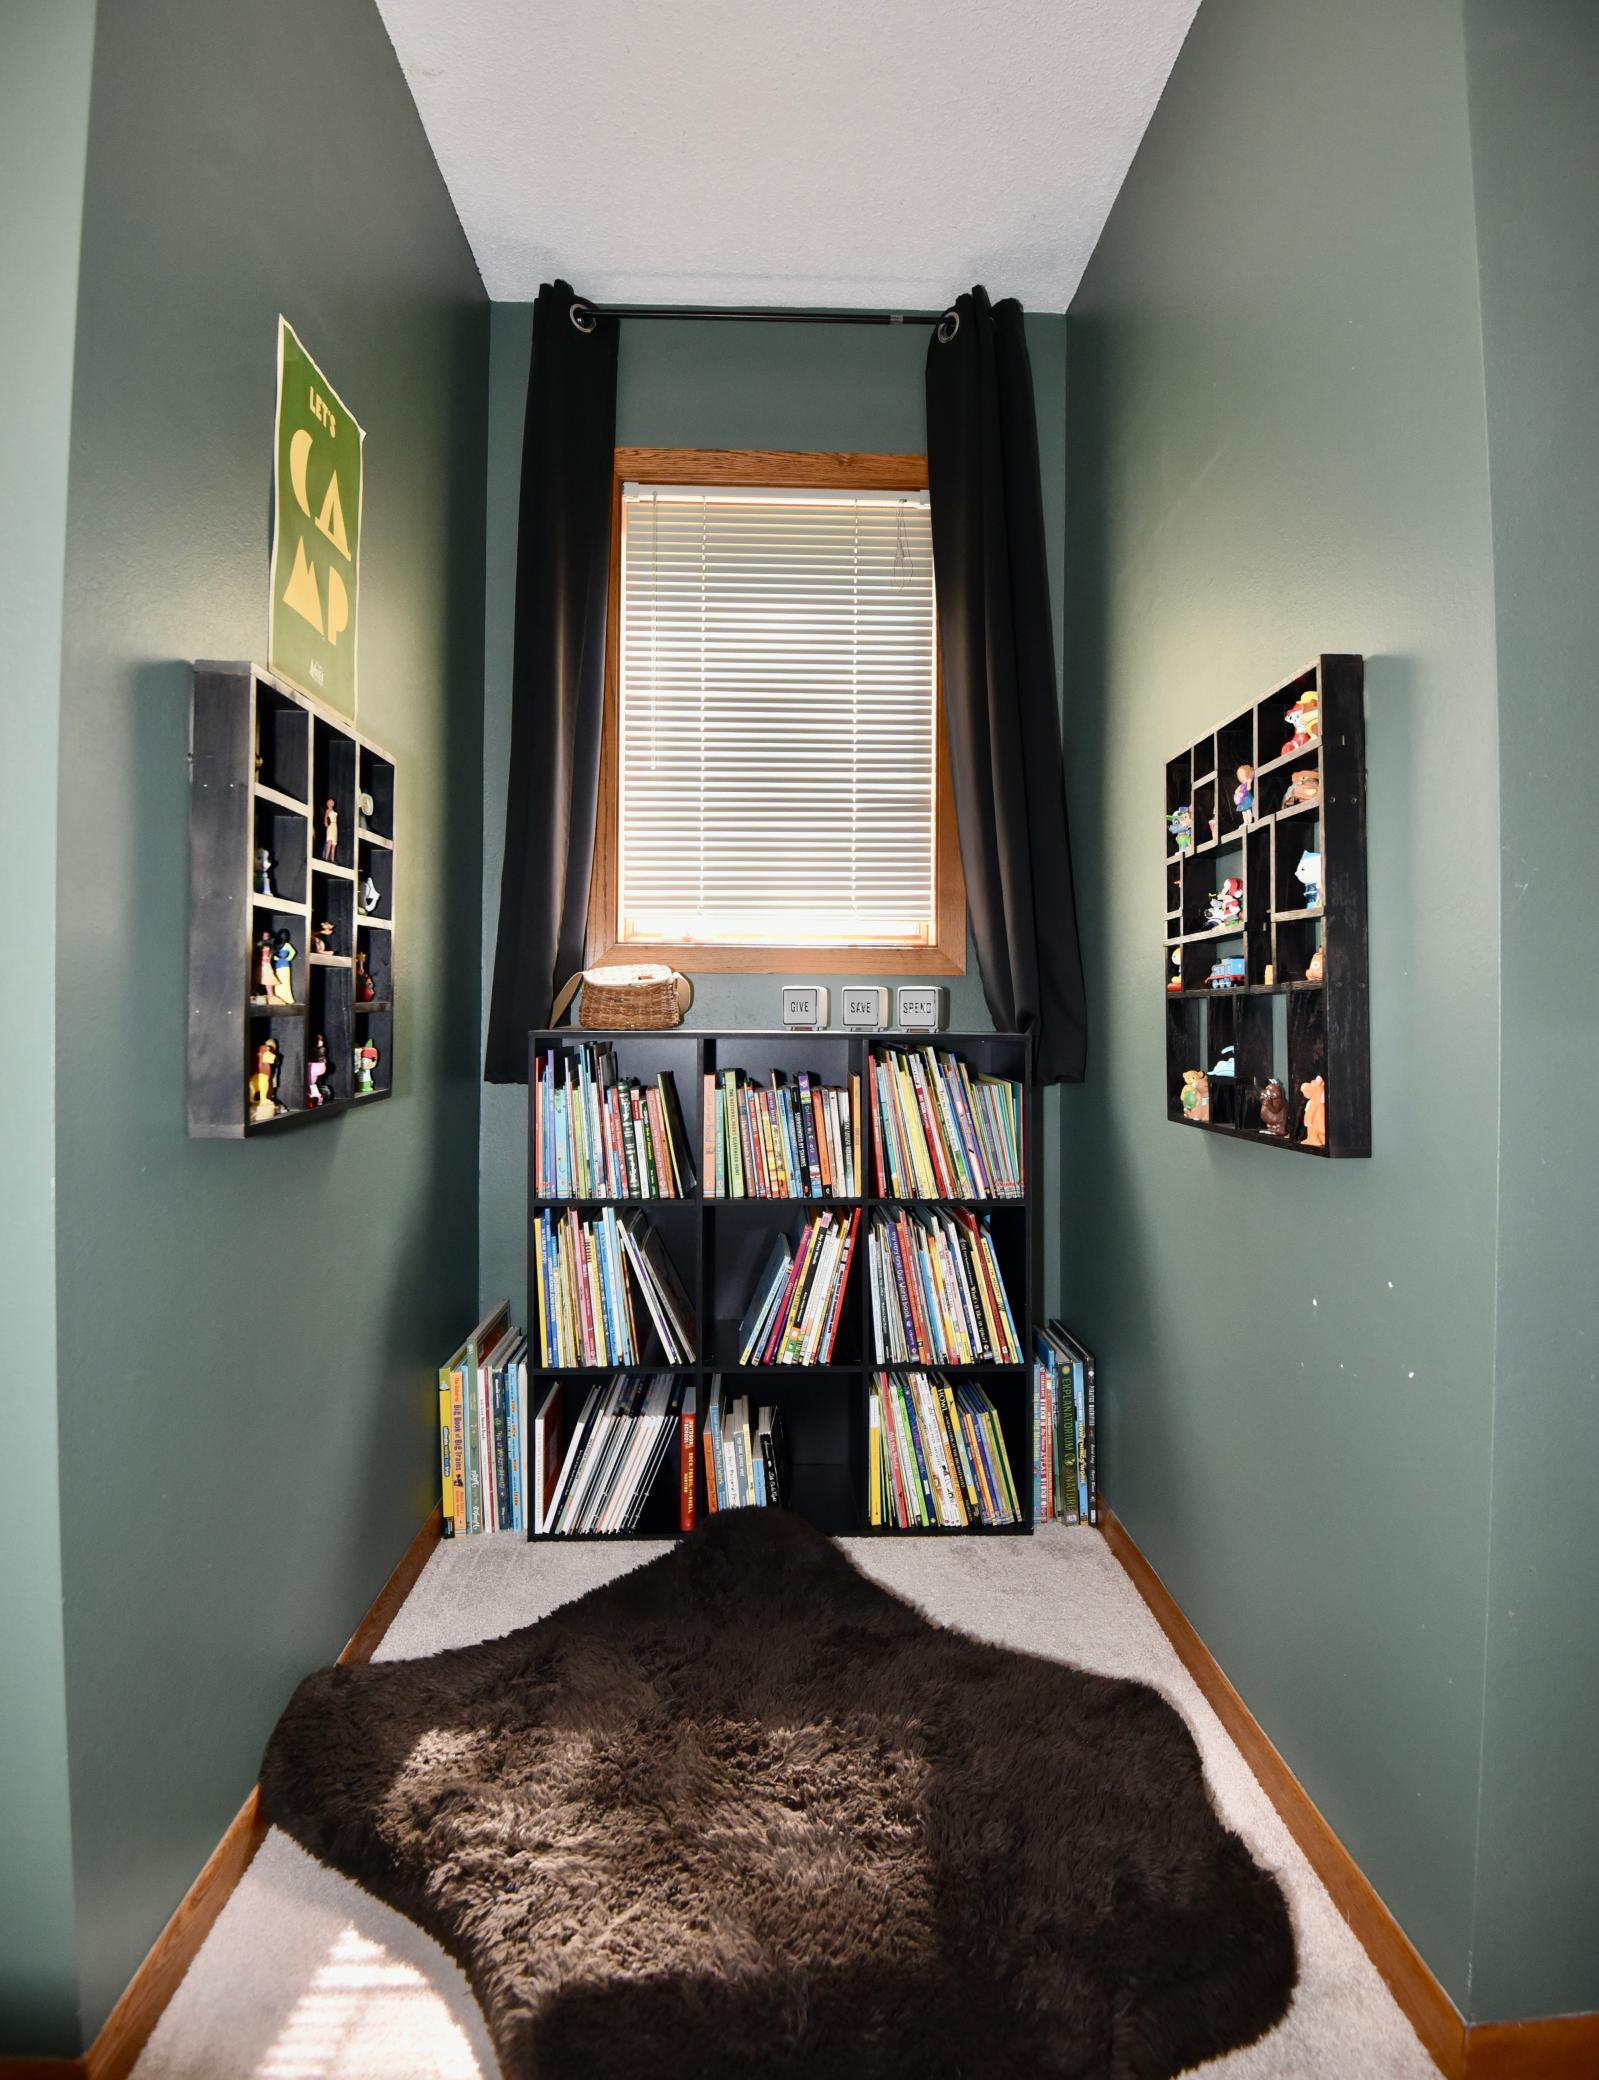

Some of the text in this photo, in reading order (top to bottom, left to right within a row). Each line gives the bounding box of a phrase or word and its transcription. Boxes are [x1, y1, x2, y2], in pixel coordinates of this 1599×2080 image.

[308, 386, 337, 440] LET'S
[790, 1002, 808, 1013] GIVE
[850, 1002, 871, 1013] SAVE
[903, 1002, 932, 1014] SPEND
[799, 1150, 807, 1167] SHARKS
[899, 1283, 907, 1301] World
[970, 1286, 978, 1304] What's
[902, 1302, 911, 1318] book
[937, 1389, 948, 1411] HOWL
[1063, 1379, 1073, 1450] EXPLANATORIUM
[454, 1417, 462, 1432] Book
[1066, 1476, 1077, 1511] NATURE
